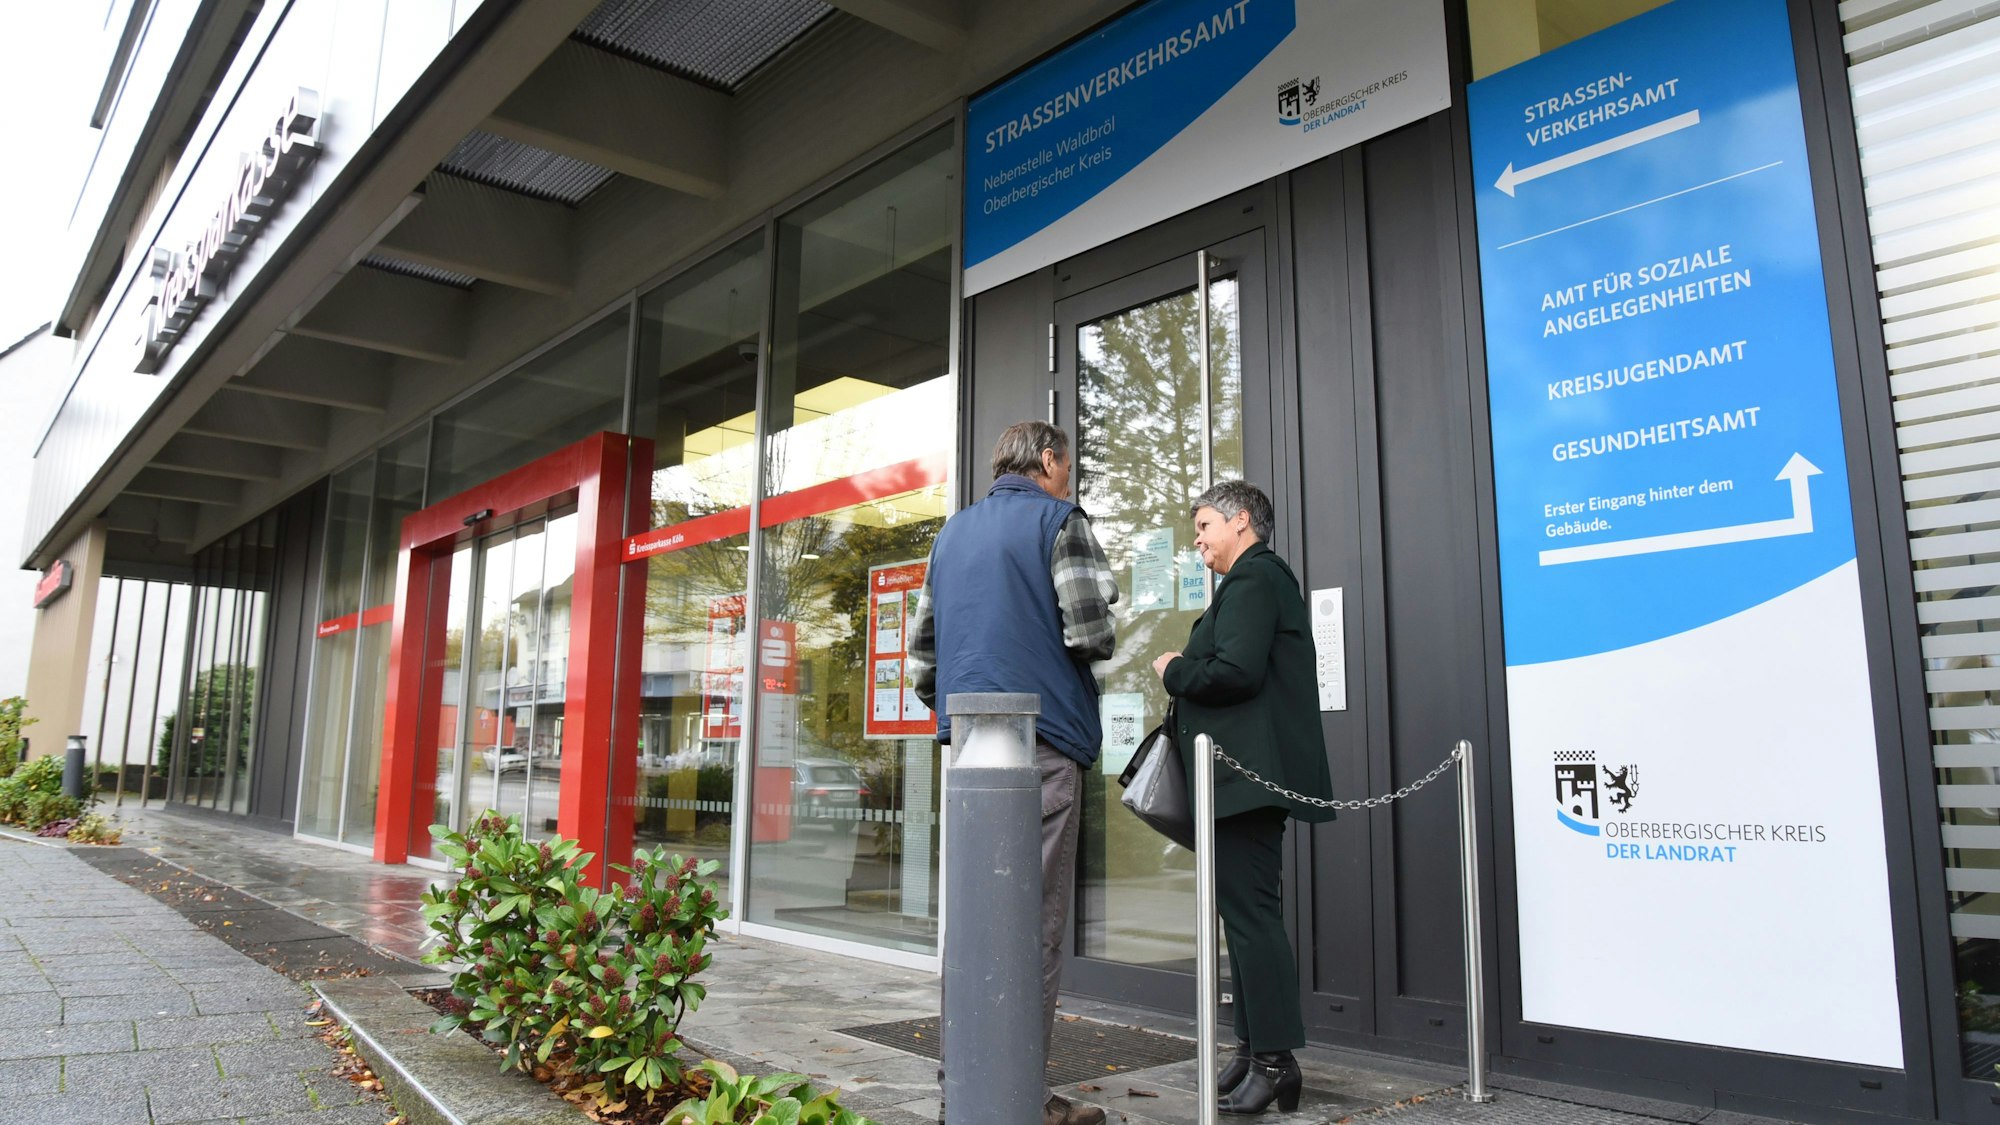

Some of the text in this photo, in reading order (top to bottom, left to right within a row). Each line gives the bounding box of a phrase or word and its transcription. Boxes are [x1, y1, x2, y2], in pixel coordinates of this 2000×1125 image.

[986, 0, 1249, 152] STRASSENVERKEHRSAMT
[1303, 71, 1407, 121] OBERBERGISCHER KREIS
[1525, 72, 1632, 123] STRASSEN-
[1304, 100, 1366, 133] DER LANDRAT
[1527, 79, 1678, 146] VERKEHRSAMT
[984, 146, 1111, 214] Oberbergischer Kreis
[985, 115, 1114, 192] Nebenstelle Waldbröl
[1542, 245, 1731, 311] AMT FÜR SOZIALE
[1544, 269, 1751, 337] ANGELEGENHEITEN
[1548, 341, 1746, 400] KREISJUGENDAMT
[1553, 407, 1760, 461] GESUNDHEITSAMT
[1545, 480, 1733, 517] Erster Eingang hinter dem
[1546, 519, 1611, 537] Gebäude.
[1606, 822, 1825, 842] OBERBERGISCHER KREIS
[1607, 844, 1736, 862] DER LANDRAT
